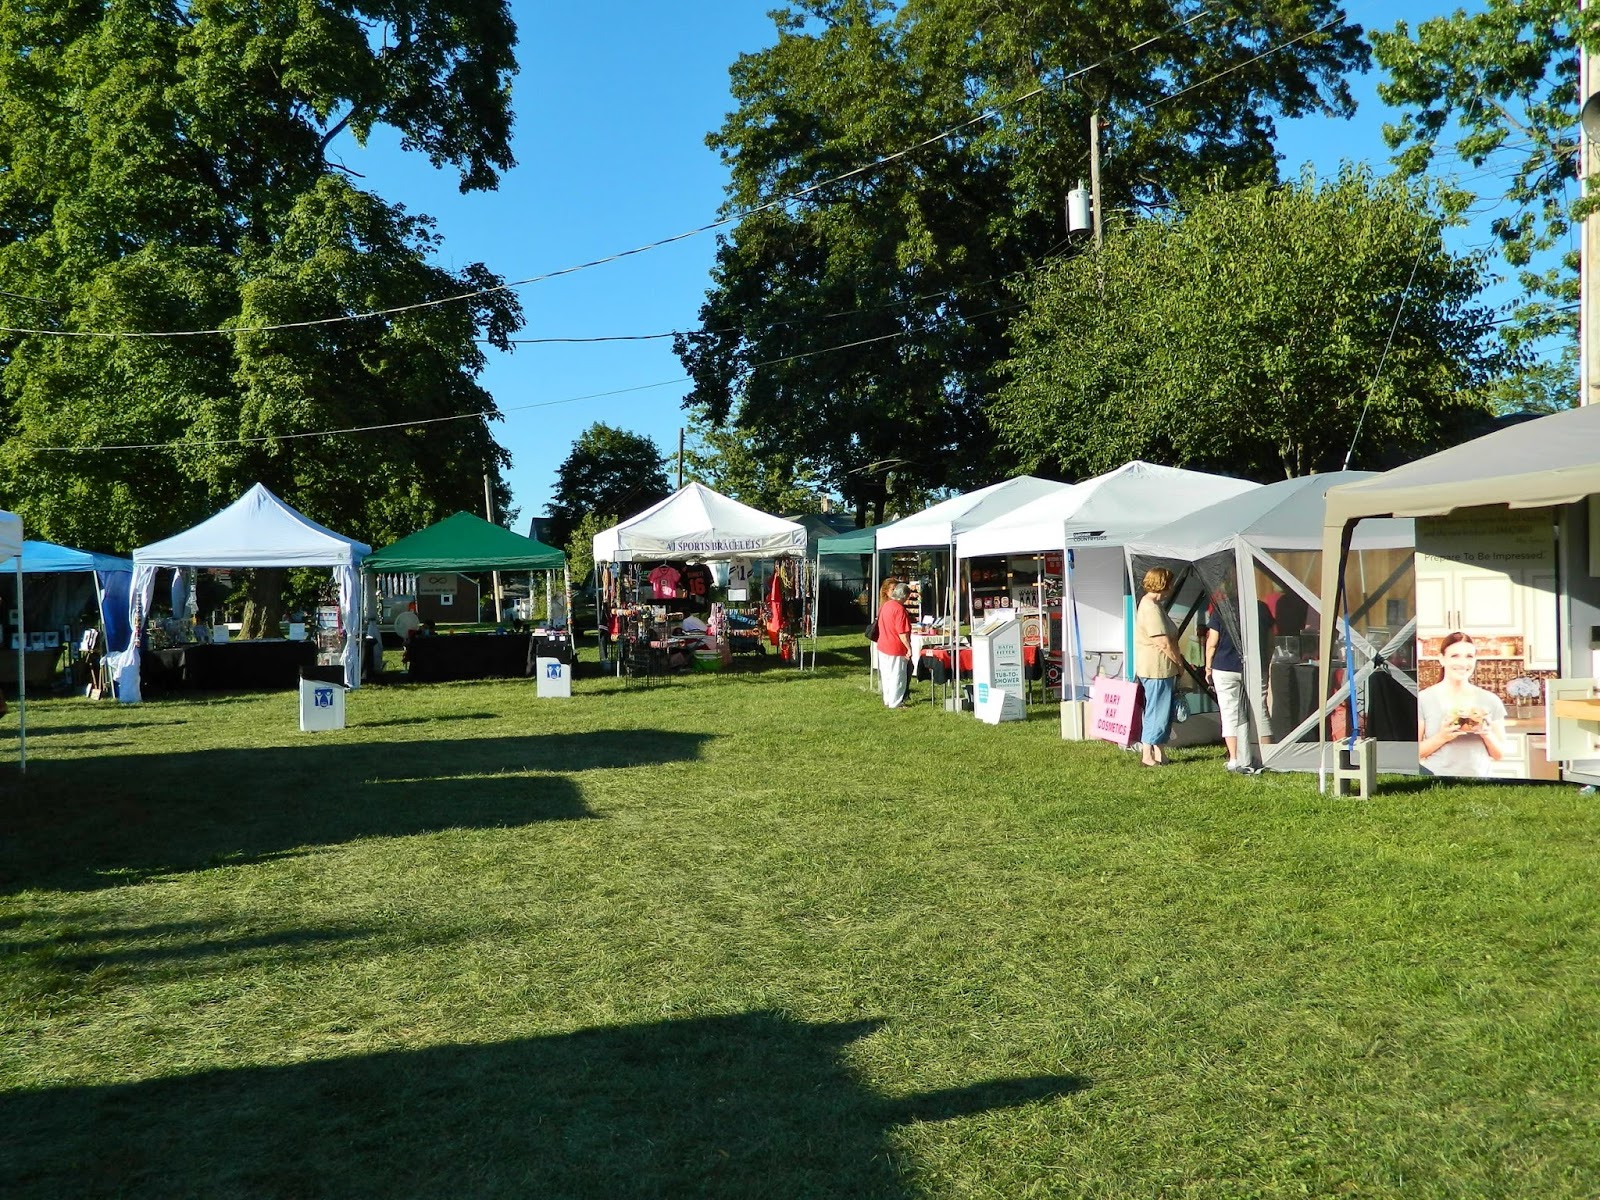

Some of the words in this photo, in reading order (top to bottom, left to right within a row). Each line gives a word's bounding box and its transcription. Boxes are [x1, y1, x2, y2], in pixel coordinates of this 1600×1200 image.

[678, 542, 710, 551] SPORTS
[712, 540, 760, 551] BRACELETS
[1424, 553, 1461, 563] Prepare
[1464, 552, 1475, 561] To
[1477, 552, 1491, 561] Be
[689, 577, 705, 595] 16
[1104, 693, 1121, 706] MARY
[1105, 707, 1117, 718] KAY
[1097, 718, 1127, 736] COSMETICS
